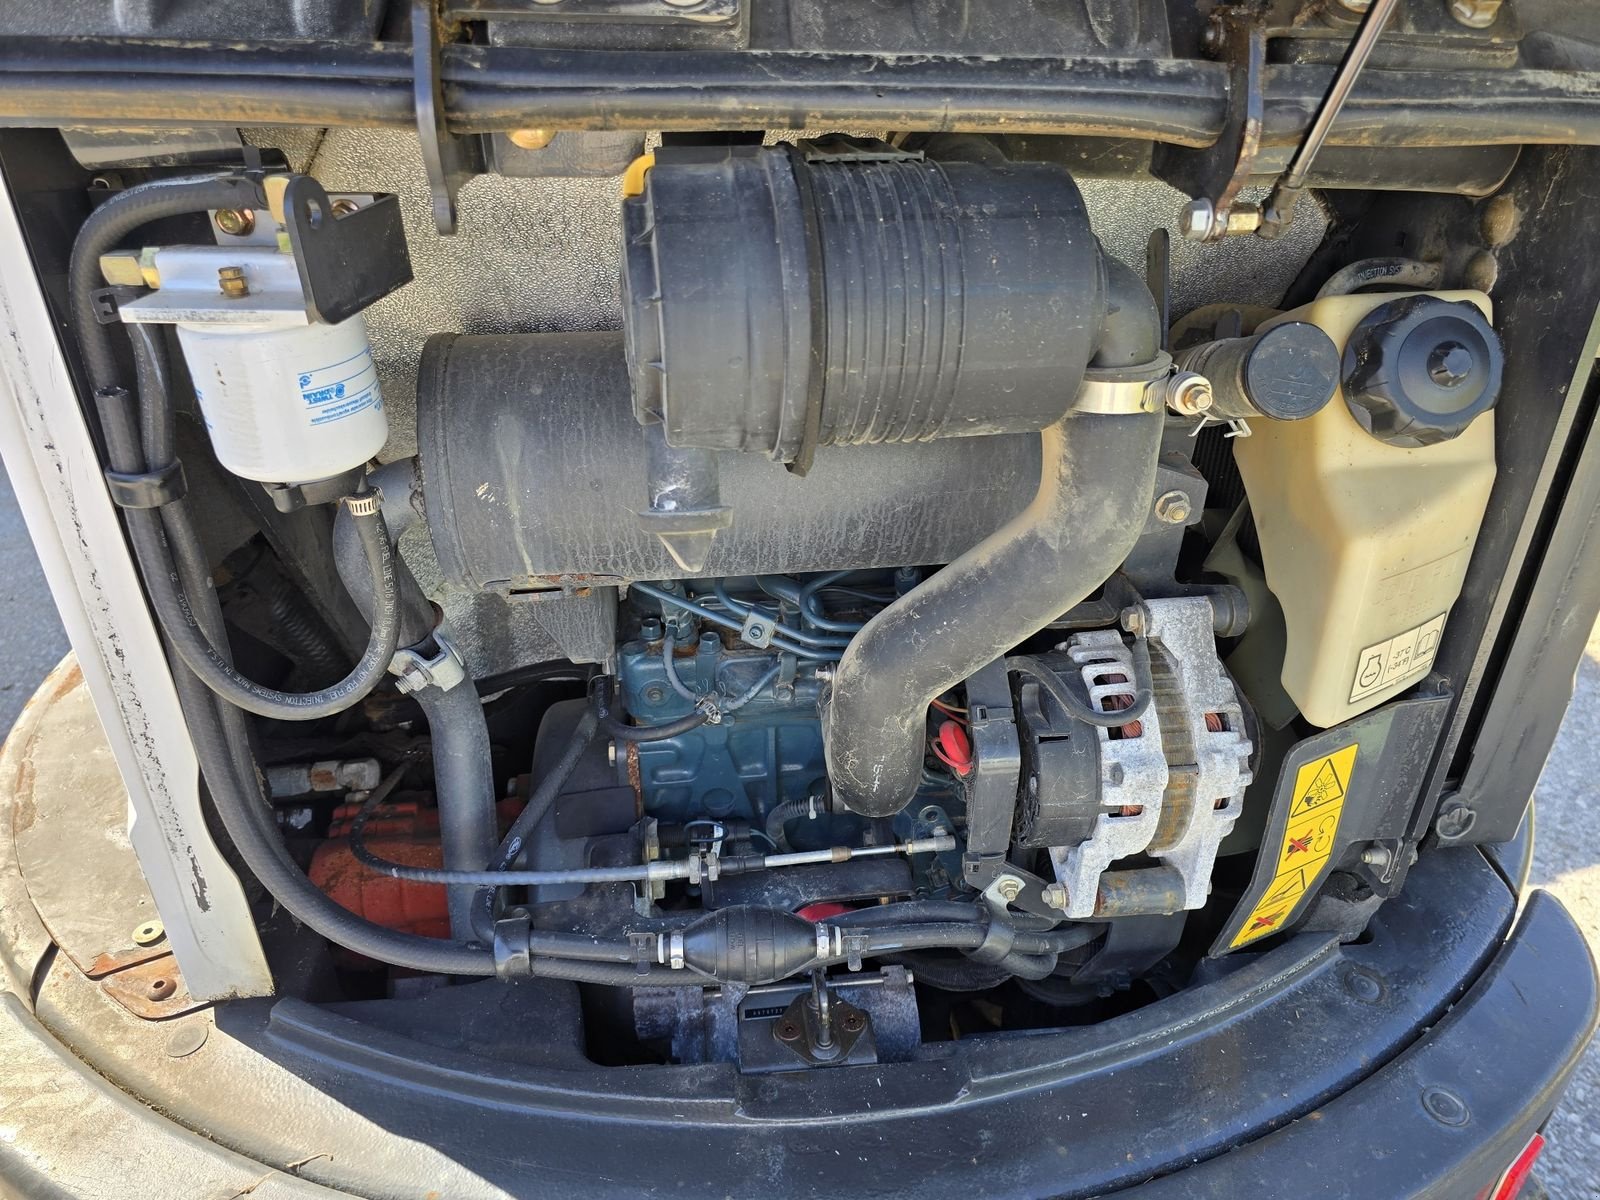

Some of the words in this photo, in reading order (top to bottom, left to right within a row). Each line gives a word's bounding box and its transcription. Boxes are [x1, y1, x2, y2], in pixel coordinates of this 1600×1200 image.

[308, 394, 333, 405] TWIST
[224, 666, 233, 676] IN
[234, 675, 252, 689] MADE
[346, 680, 359, 692] FOR
[252, 686, 282, 702] SYSTEMS
[328, 689, 346, 700] FUEL
[285, 695, 324, 706] INJECTION
